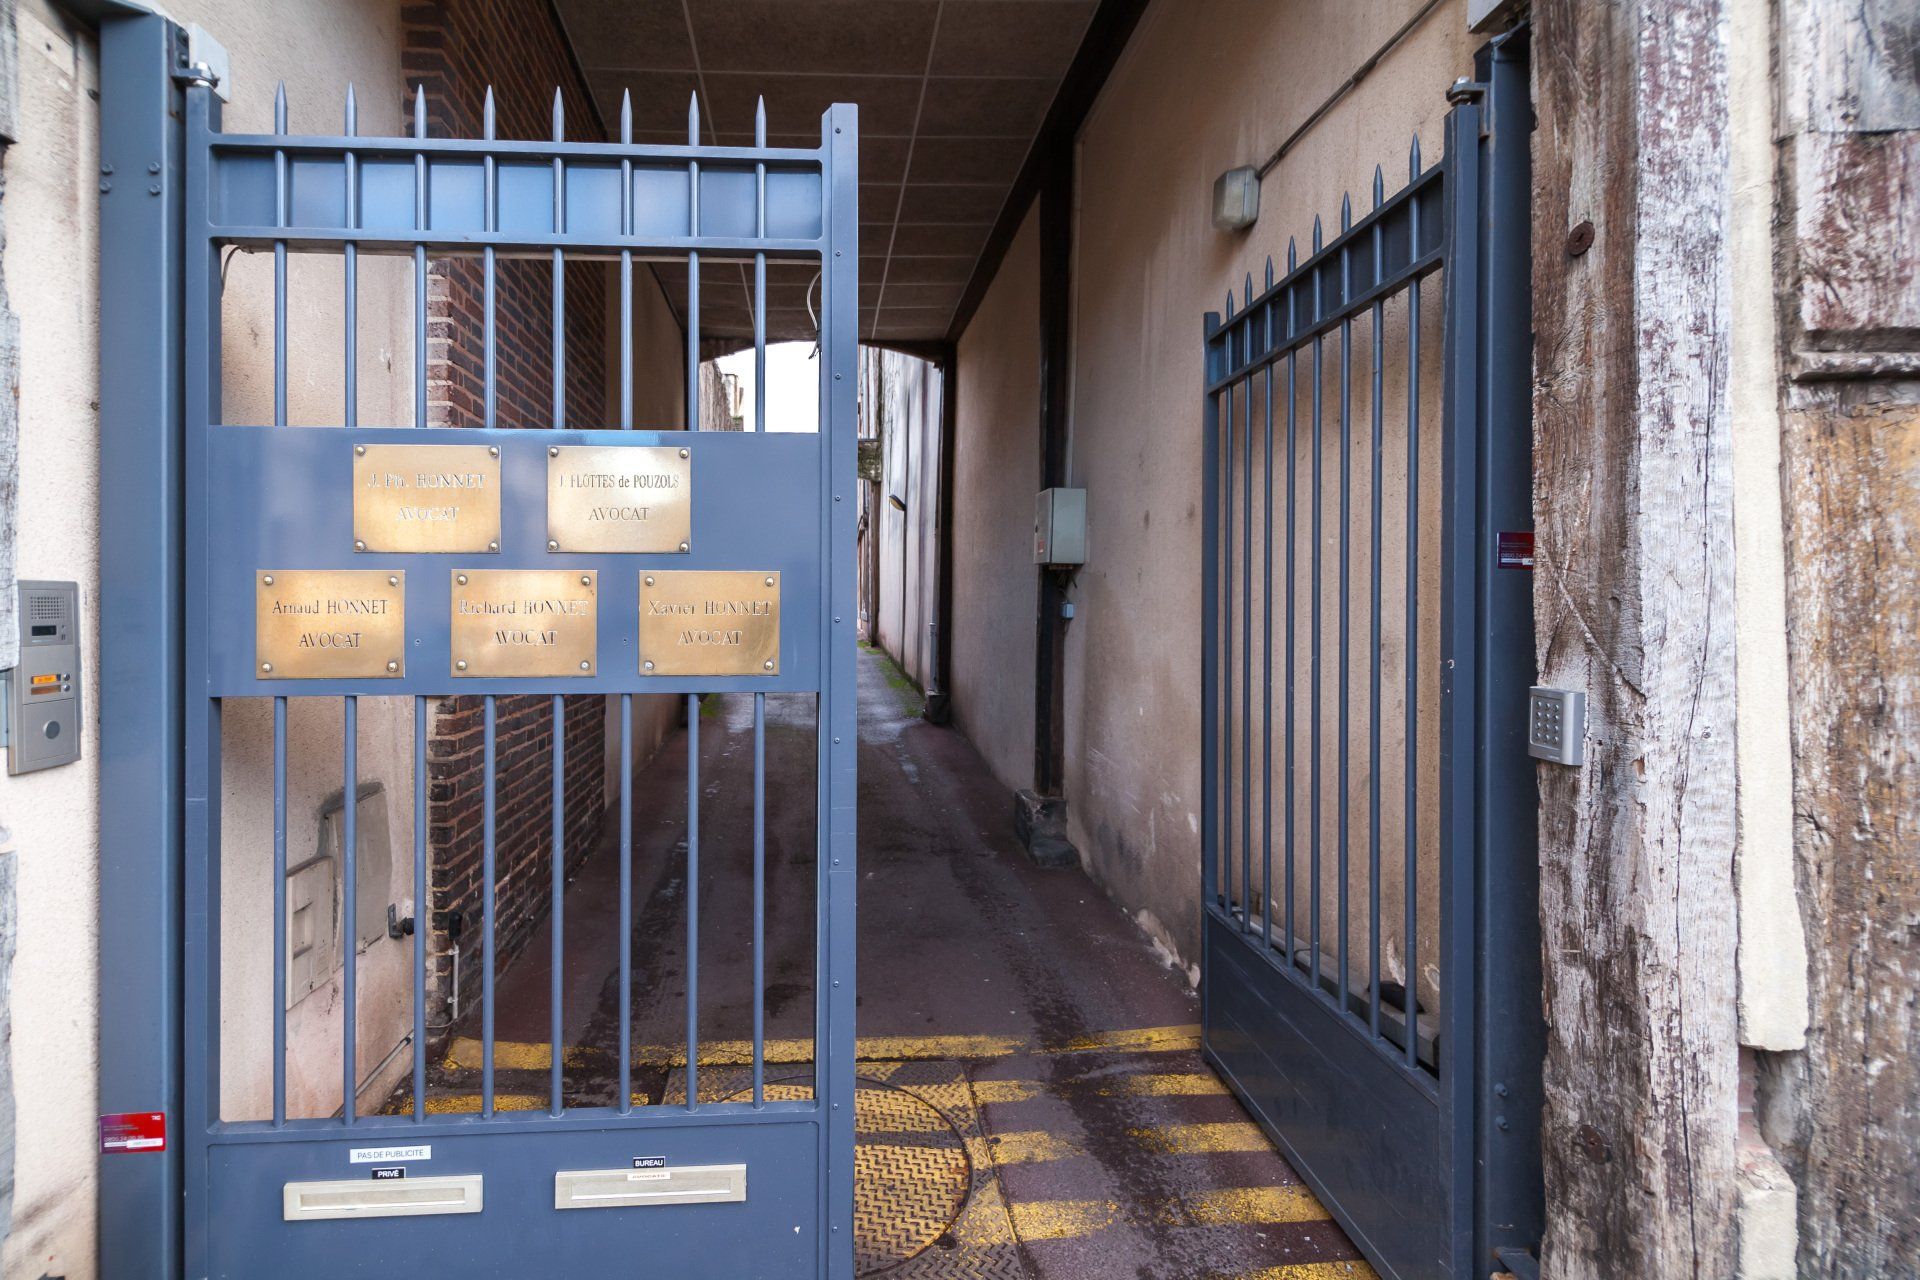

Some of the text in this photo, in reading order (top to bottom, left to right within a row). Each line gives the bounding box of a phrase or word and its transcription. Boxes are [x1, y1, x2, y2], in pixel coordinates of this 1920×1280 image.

[416, 473, 486, 489] HONNET
[570, 474, 615, 489] FLOTTES
[618, 475, 630, 489] de
[633, 474, 680, 489] POUZOLS
[396, 506, 460, 522] AVOCAT
[588, 506, 650, 521] AVOCAT
[272, 600, 389, 615] Arnaud HONNET
[458, 600, 589, 616] Richard HONNET
[648, 600, 773, 616] Xavier HONNET
[298, 632, 362, 648] AVOCAT
[492, 630, 558, 646] AVOCAT
[677, 630, 743, 646] AVOCAT
[357, 1149, 424, 1160] PAS DE PUBLICITÉ
[635, 1159, 663, 1167] BUREAU
[377, 1169, 399, 1177] PRIVÉ
